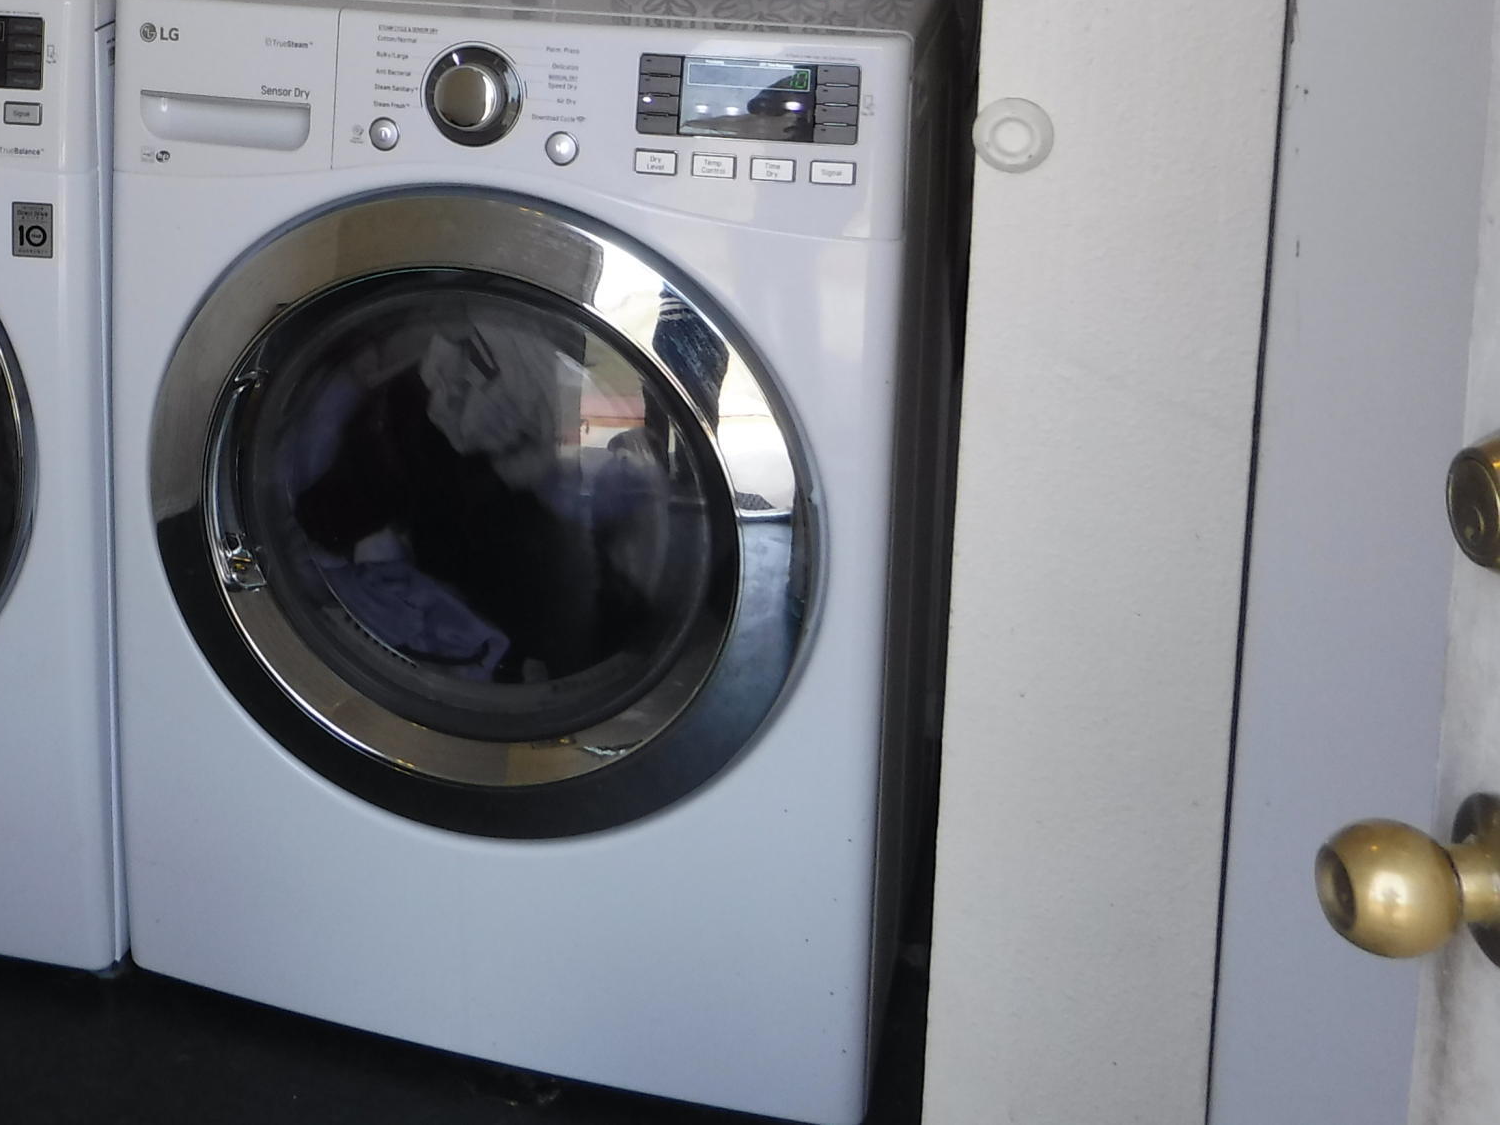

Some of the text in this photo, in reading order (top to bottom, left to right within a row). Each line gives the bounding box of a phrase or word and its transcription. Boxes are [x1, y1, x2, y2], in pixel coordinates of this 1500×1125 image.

[159, 27, 180, 42] LG
[261, 84, 311, 100] Sensor Dry
